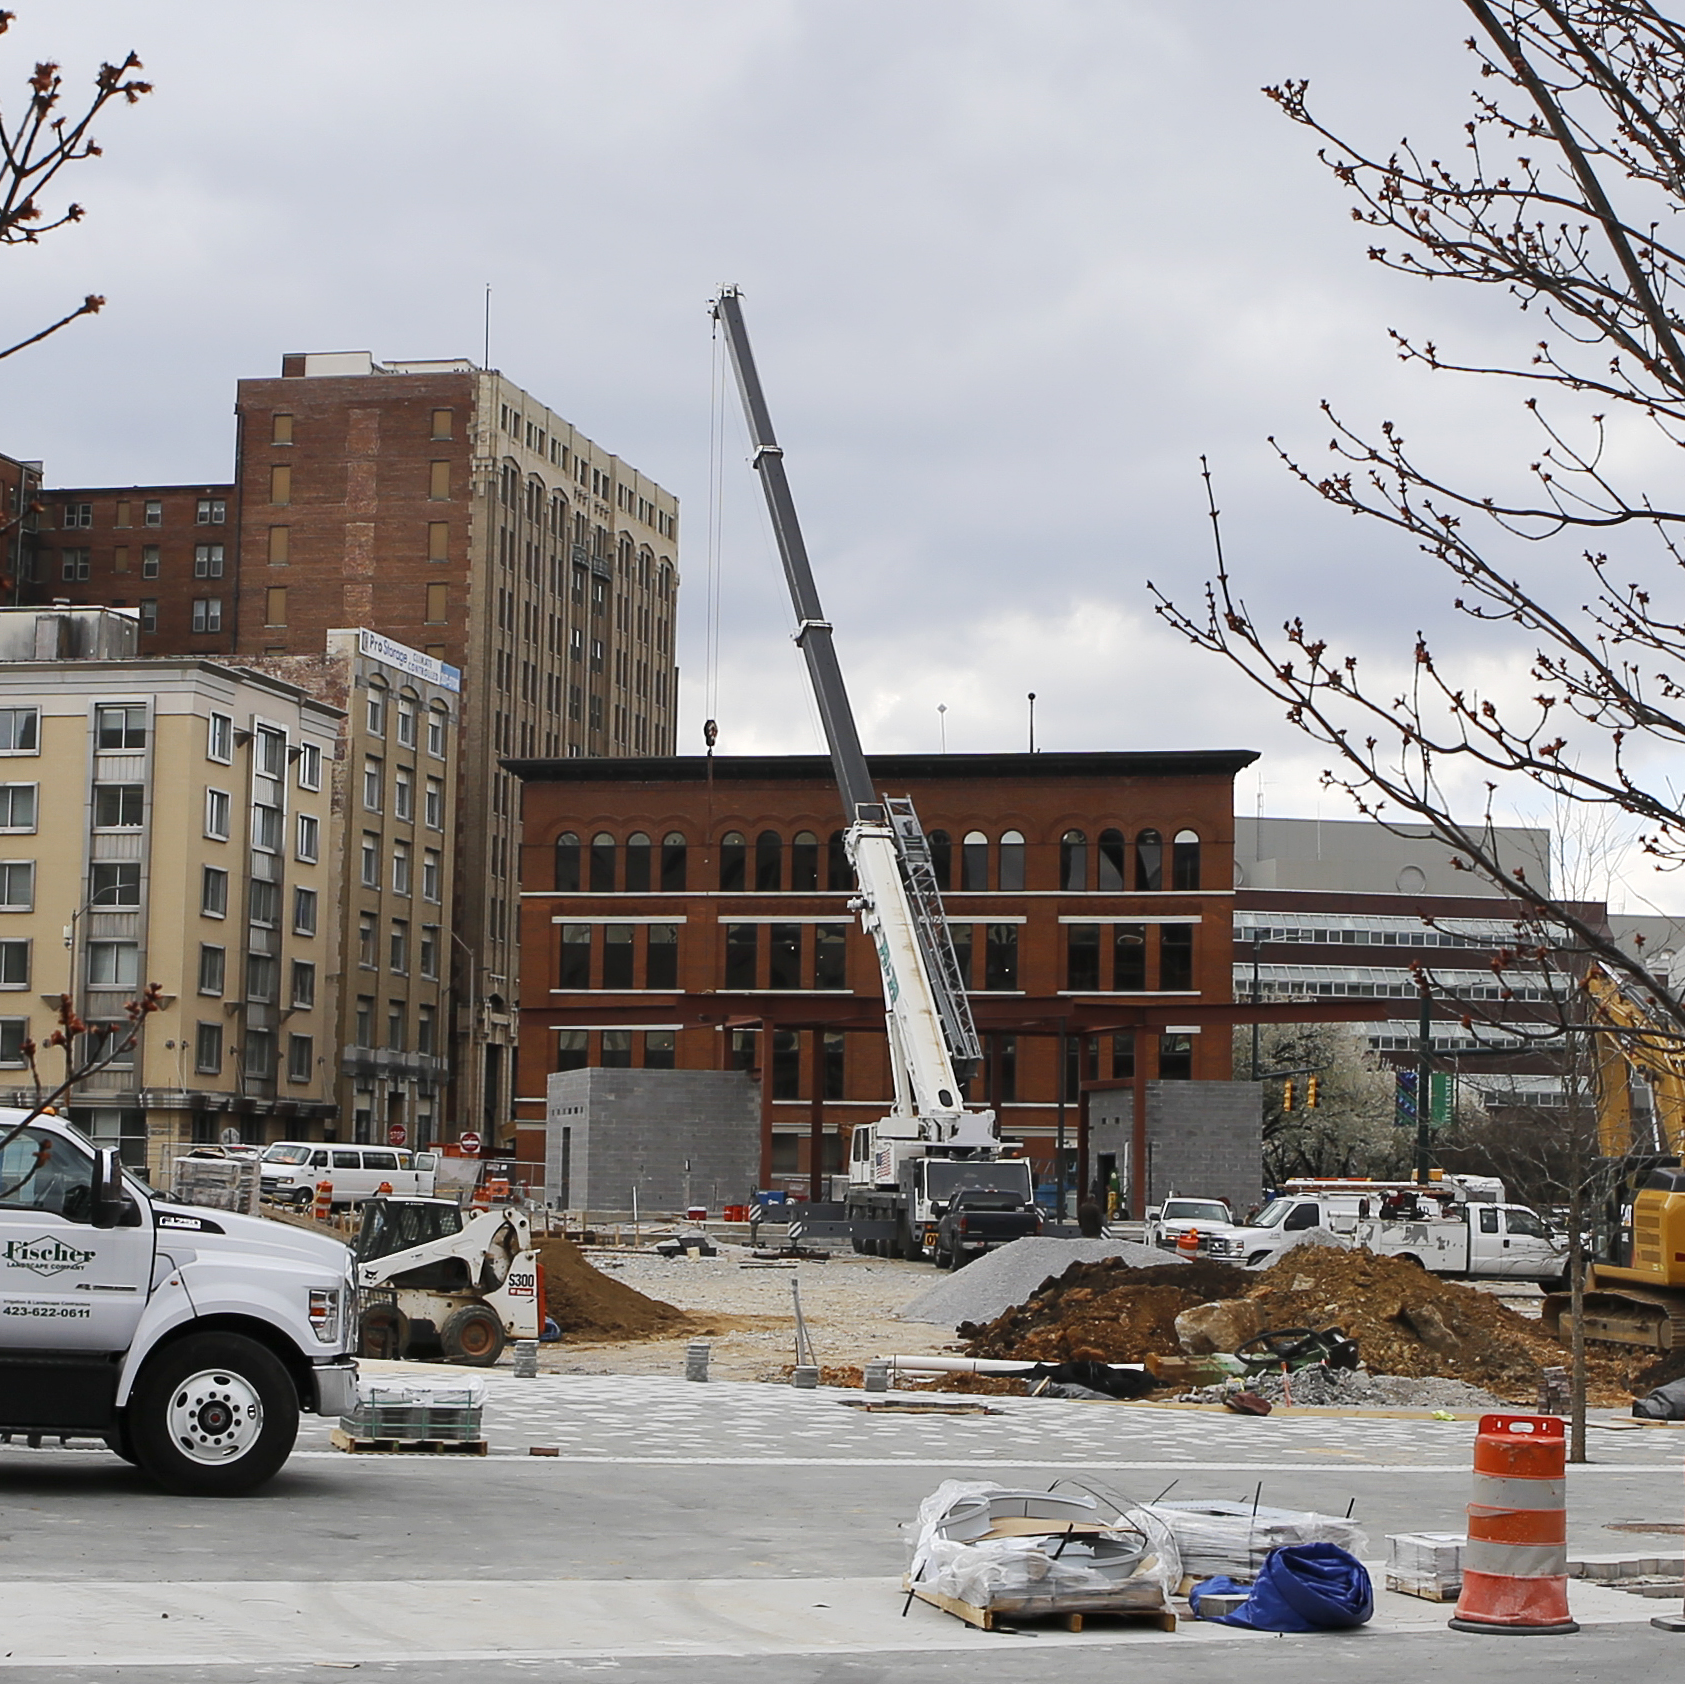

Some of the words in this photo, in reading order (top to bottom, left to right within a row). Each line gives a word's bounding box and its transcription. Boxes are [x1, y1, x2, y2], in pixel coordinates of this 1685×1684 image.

[5, 1240, 96, 1263] Fischer
[7, 1262, 49, 1270] LANDSCAPE
[50, 1263, 86, 1271] COMPANY
[508, 1273, 535, 1288] S300
[2, 1306, 91, 1318] 423-622-0611
